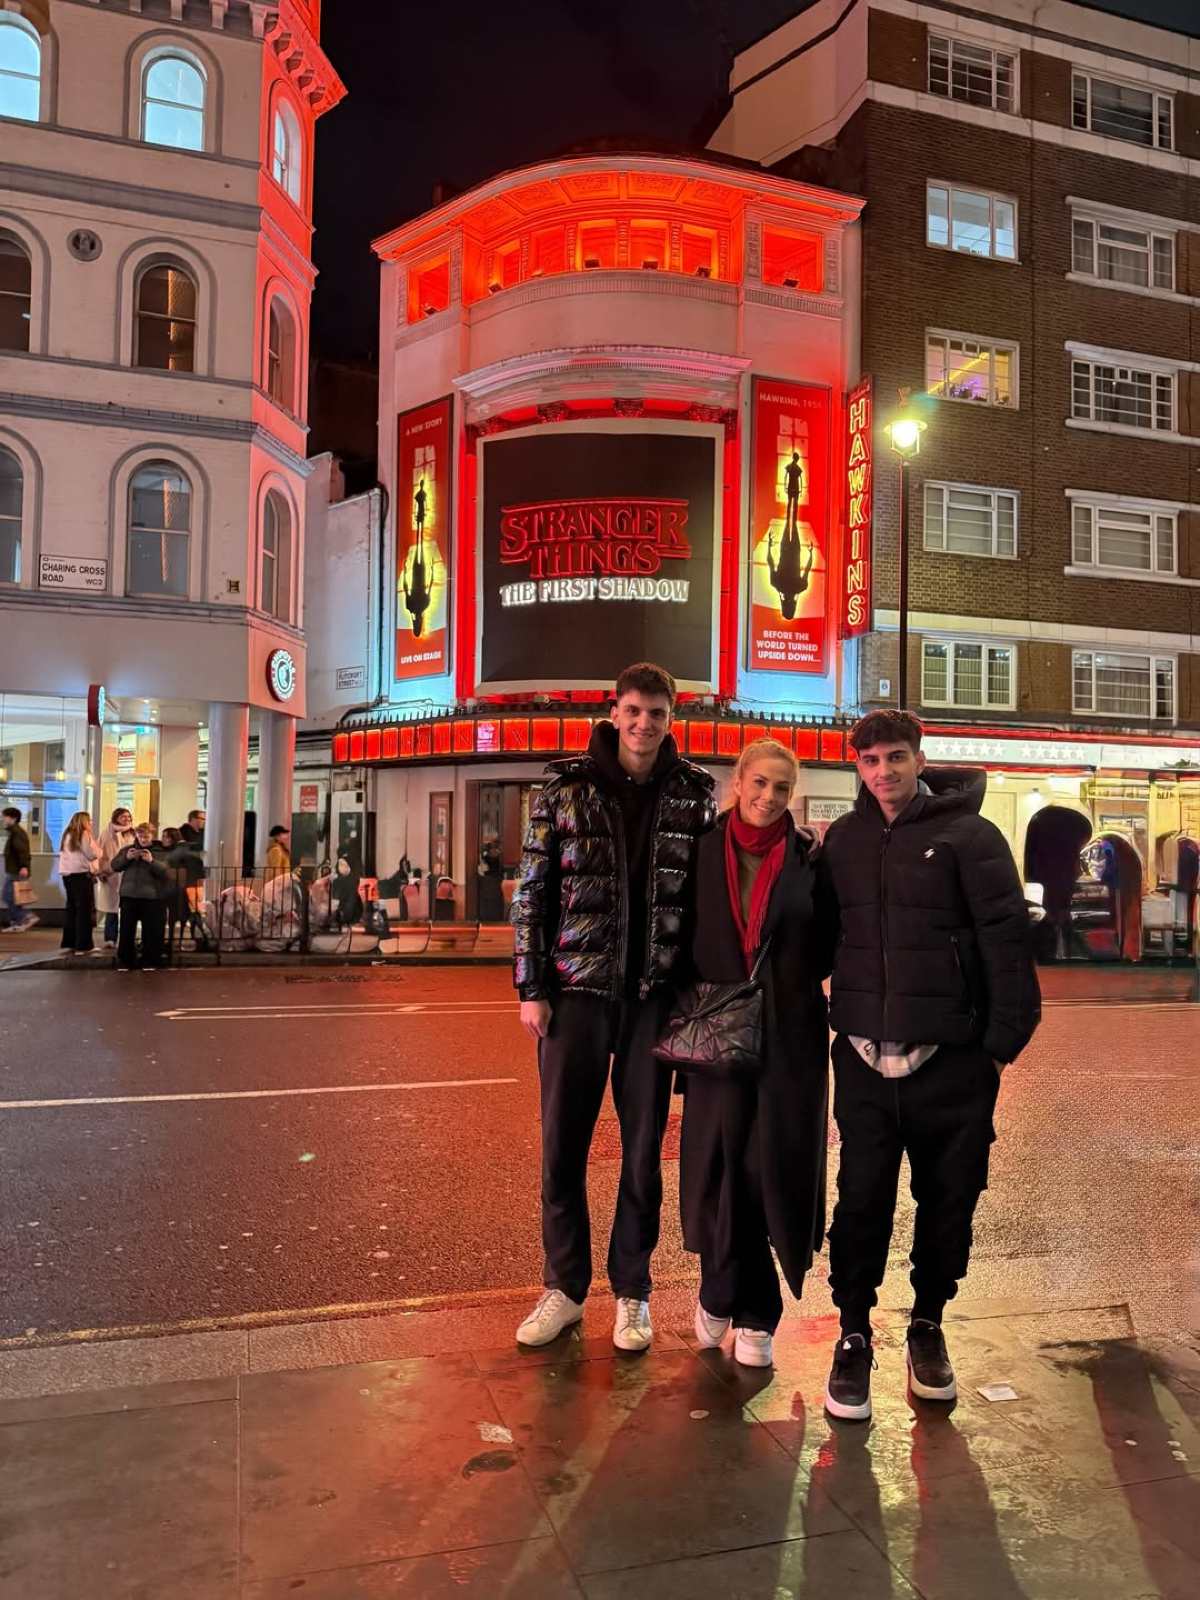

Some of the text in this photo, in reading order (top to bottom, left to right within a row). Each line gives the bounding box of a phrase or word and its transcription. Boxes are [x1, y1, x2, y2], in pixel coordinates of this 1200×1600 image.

[759, 392, 801, 407] HAWKINS,
[848, 398, 867, 625] HAWKINS
[500, 502, 691, 557] STRANGER
[530, 540, 662, 578] THINGS
[42, 563, 105, 575] CHARING CROSS
[42, 573, 64, 583] ROAD
[500, 576, 690, 607] THE FIRST SHADOW
[763, 630, 809, 641] BEFORE THE
[756, 640, 818, 652] WORLD TURNED
[413, 653, 423, 662] ON
[423, 650, 442, 661] STAGE
[758, 651, 786, 660] UPSIDE
